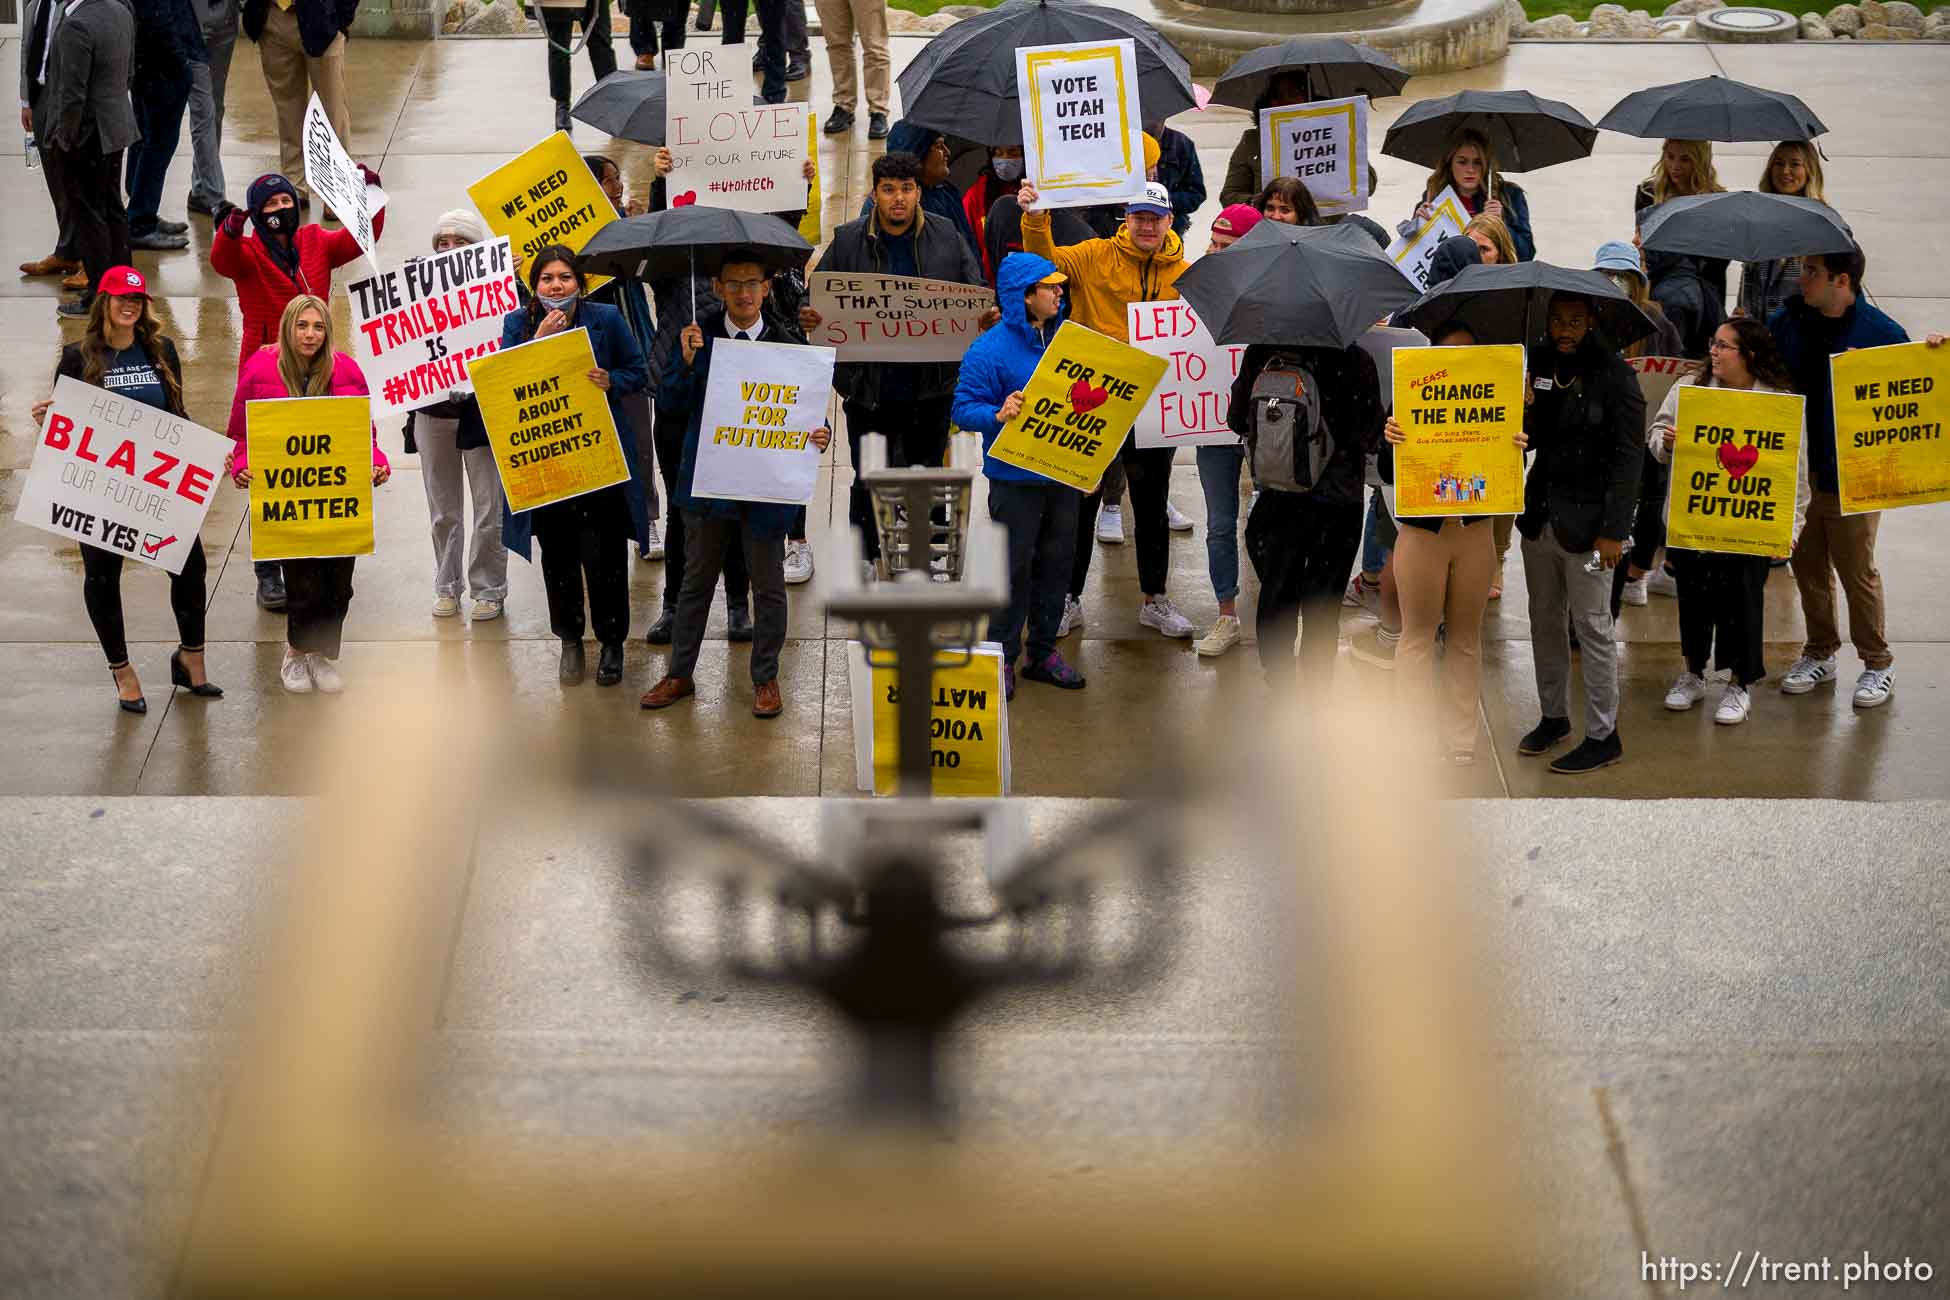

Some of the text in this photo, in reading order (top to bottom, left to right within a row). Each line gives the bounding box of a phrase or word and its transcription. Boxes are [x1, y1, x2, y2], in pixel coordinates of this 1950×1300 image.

[668, 51, 717, 77] FOR
[690, 80, 735, 100] THE
[1051, 75, 1098, 95] VOTE
[1056, 98, 1104, 118] UTAH
[672, 107, 800, 146] LOVE
[1059, 122, 1105, 141] TECH
[1291, 127, 1333, 144] VOTE
[672, 149, 797, 168] OF OUR FUTURE
[1294, 143, 1336, 161] UTAH
[1296, 160, 1336, 178] TECH
[501, 169, 568, 219] WE NEED
[526, 196, 568, 229] YOUR
[523, 203, 596, 258] SUPPORT!
[348, 242, 509, 320] THE FUTURE OF
[825, 279, 862, 292] BE
[875, 279, 921, 292] THE
[834, 295, 892, 309] THAT
[360, 275, 517, 357] TRAILBLAZERS
[875, 310, 918, 320] OUR
[1134, 305, 1197, 342] LET'S
[425, 335, 448, 361] IS
[383, 337, 503, 406] #UTAHT
[1169, 351, 1207, 381] TO
[513, 375, 560, 402] WHAT
[1054, 358, 1139, 402] FOR THE
[1410, 369, 1449, 389] PLEASE
[1854, 376, 1934, 401] WE NEED
[741, 381, 800, 405] VOTE
[1421, 383, 1495, 401] CHANGE
[89, 398, 184, 446] HELP US
[518, 395, 569, 424] ABOUT
[743, 405, 788, 427] FOR
[1033, 397, 1107, 437] OF OUR
[1159, 391, 1231, 434] FUTU
[1411, 406, 1506, 425] THE NAME
[1872, 402, 1918, 422] YOUR
[510, 413, 583, 447] CURRENT
[713, 425, 810, 450] FUTURE!
[1020, 416, 1102, 457] FUTURE
[1693, 425, 1785, 450] FOR THE
[1854, 423, 1941, 448] SUPPORT!
[286, 434, 332, 456] OUR
[510, 430, 602, 469] STUDENTS?
[44, 413, 215, 505] BLAZE
[264, 466, 347, 489] VOICES
[1691, 471, 1772, 497] OF OUR
[60, 461, 170, 522] OUR FUTURE
[263, 497, 359, 522] MATTER
[1688, 495, 1776, 521] FUTURE
[50, 502, 139, 553] VOTE YES
[929, 718, 983, 741] VOIC
[930, 749, 961, 768] OU
